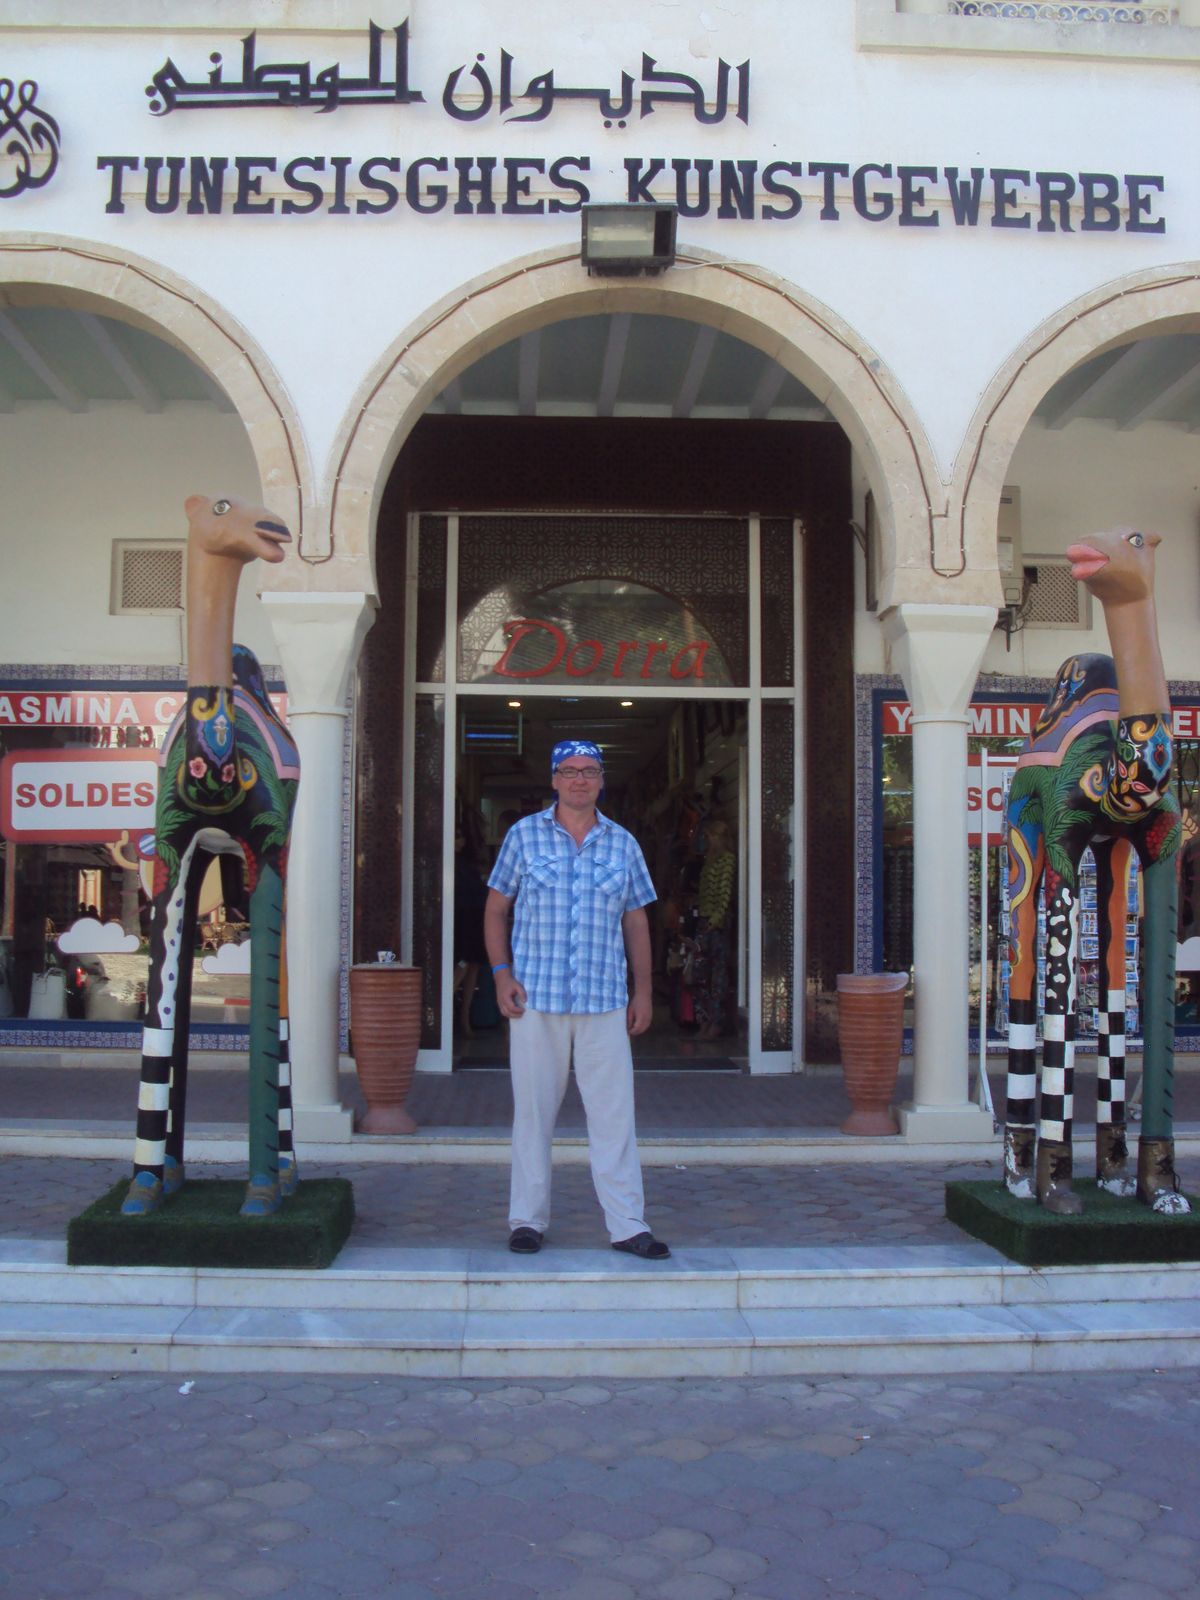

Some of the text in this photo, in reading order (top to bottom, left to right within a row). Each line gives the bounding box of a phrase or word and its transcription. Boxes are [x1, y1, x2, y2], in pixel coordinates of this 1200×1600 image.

[97, 156, 1166, 234] TUNESISGHES KUNSTGEWERBE
[493, 618, 710, 680] Dorra
[15, 782, 156, 808] SOLDES
